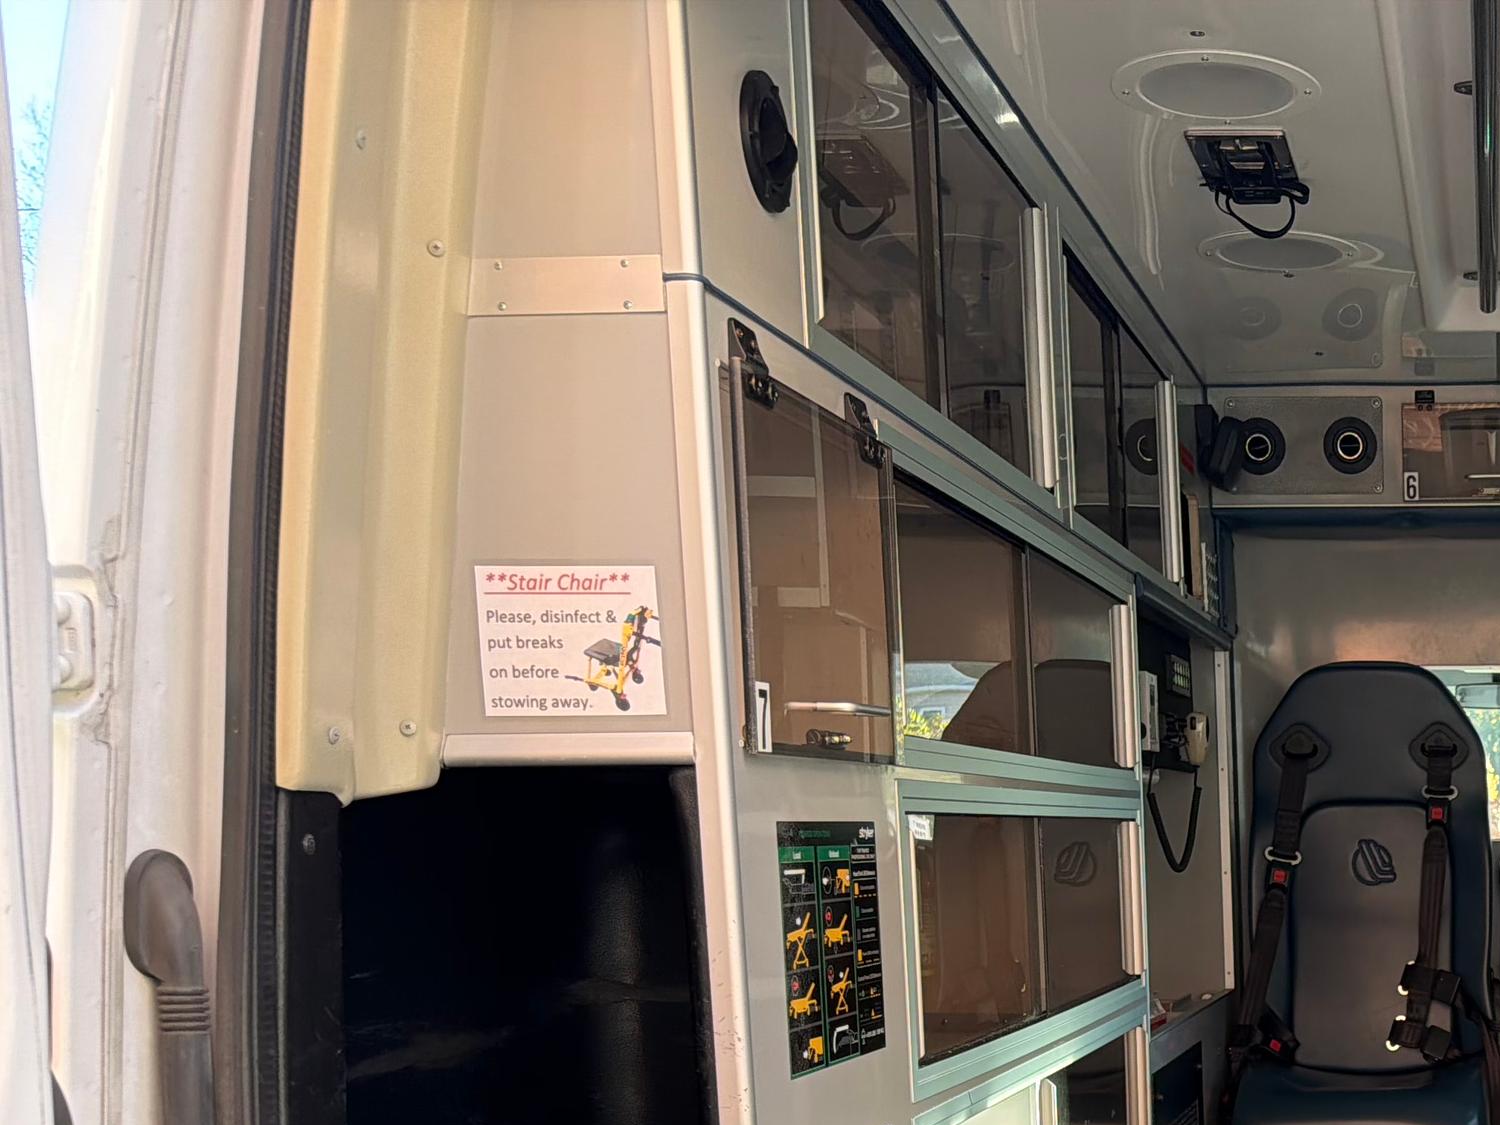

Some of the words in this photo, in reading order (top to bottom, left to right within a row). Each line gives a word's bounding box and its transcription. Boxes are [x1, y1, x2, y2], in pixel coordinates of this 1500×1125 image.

[1406, 474, 1417, 499] 6
[486, 609, 537, 625] Please,
[540, 609, 602, 623] disinfect
[605, 609, 617, 623] &
[487, 638, 512, 652] put
[516, 635, 564, 649] breaks
[489, 668, 508, 679] on
[512, 665, 560, 679] before
[491, 695, 548, 711] stowing
[551, 699, 594, 711] away.
